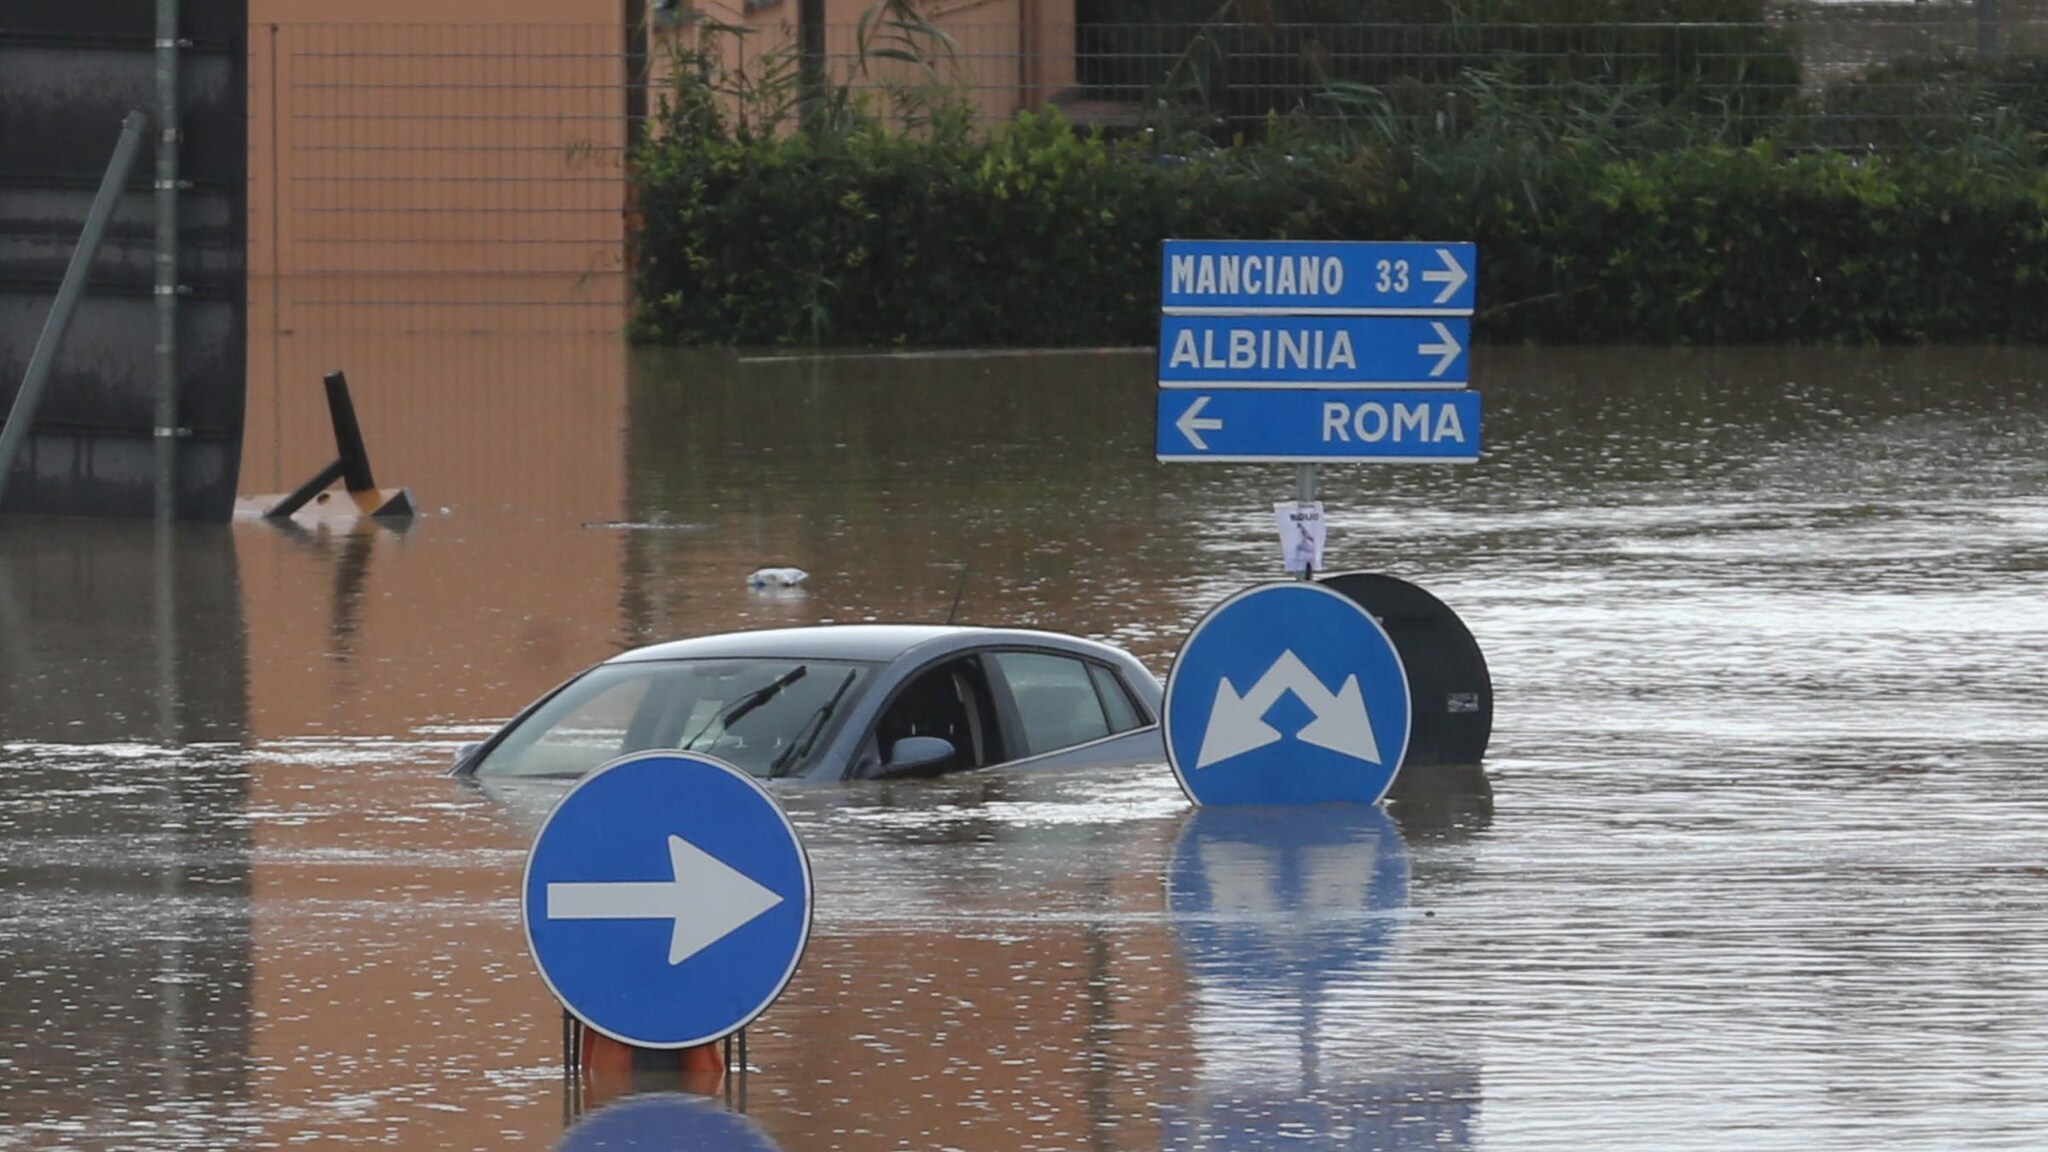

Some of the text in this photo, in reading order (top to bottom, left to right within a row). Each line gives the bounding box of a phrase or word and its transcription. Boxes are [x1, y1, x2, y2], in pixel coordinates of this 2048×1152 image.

[1170, 254, 1410, 295] MANCIANO 33
[1169, 329, 1357, 370] ALBINIA
[1322, 402, 1465, 443] ROMA
